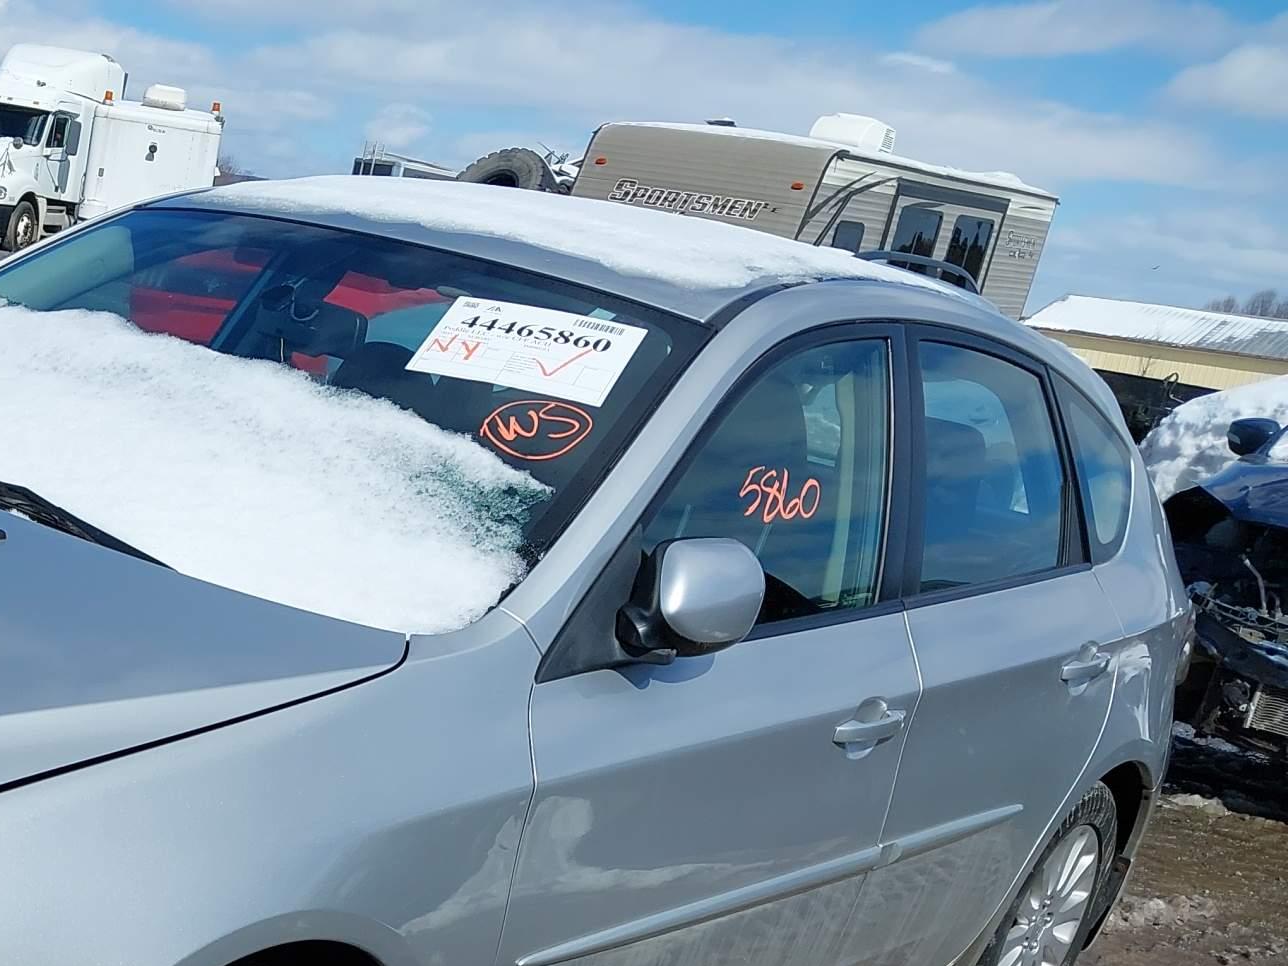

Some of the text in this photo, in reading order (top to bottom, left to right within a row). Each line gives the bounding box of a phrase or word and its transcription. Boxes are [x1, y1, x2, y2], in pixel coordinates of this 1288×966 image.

[608, 178, 764, 221] SPORTSMEN
[461, 316, 613, 352] 44465860
[739, 465, 821, 523] 5860
